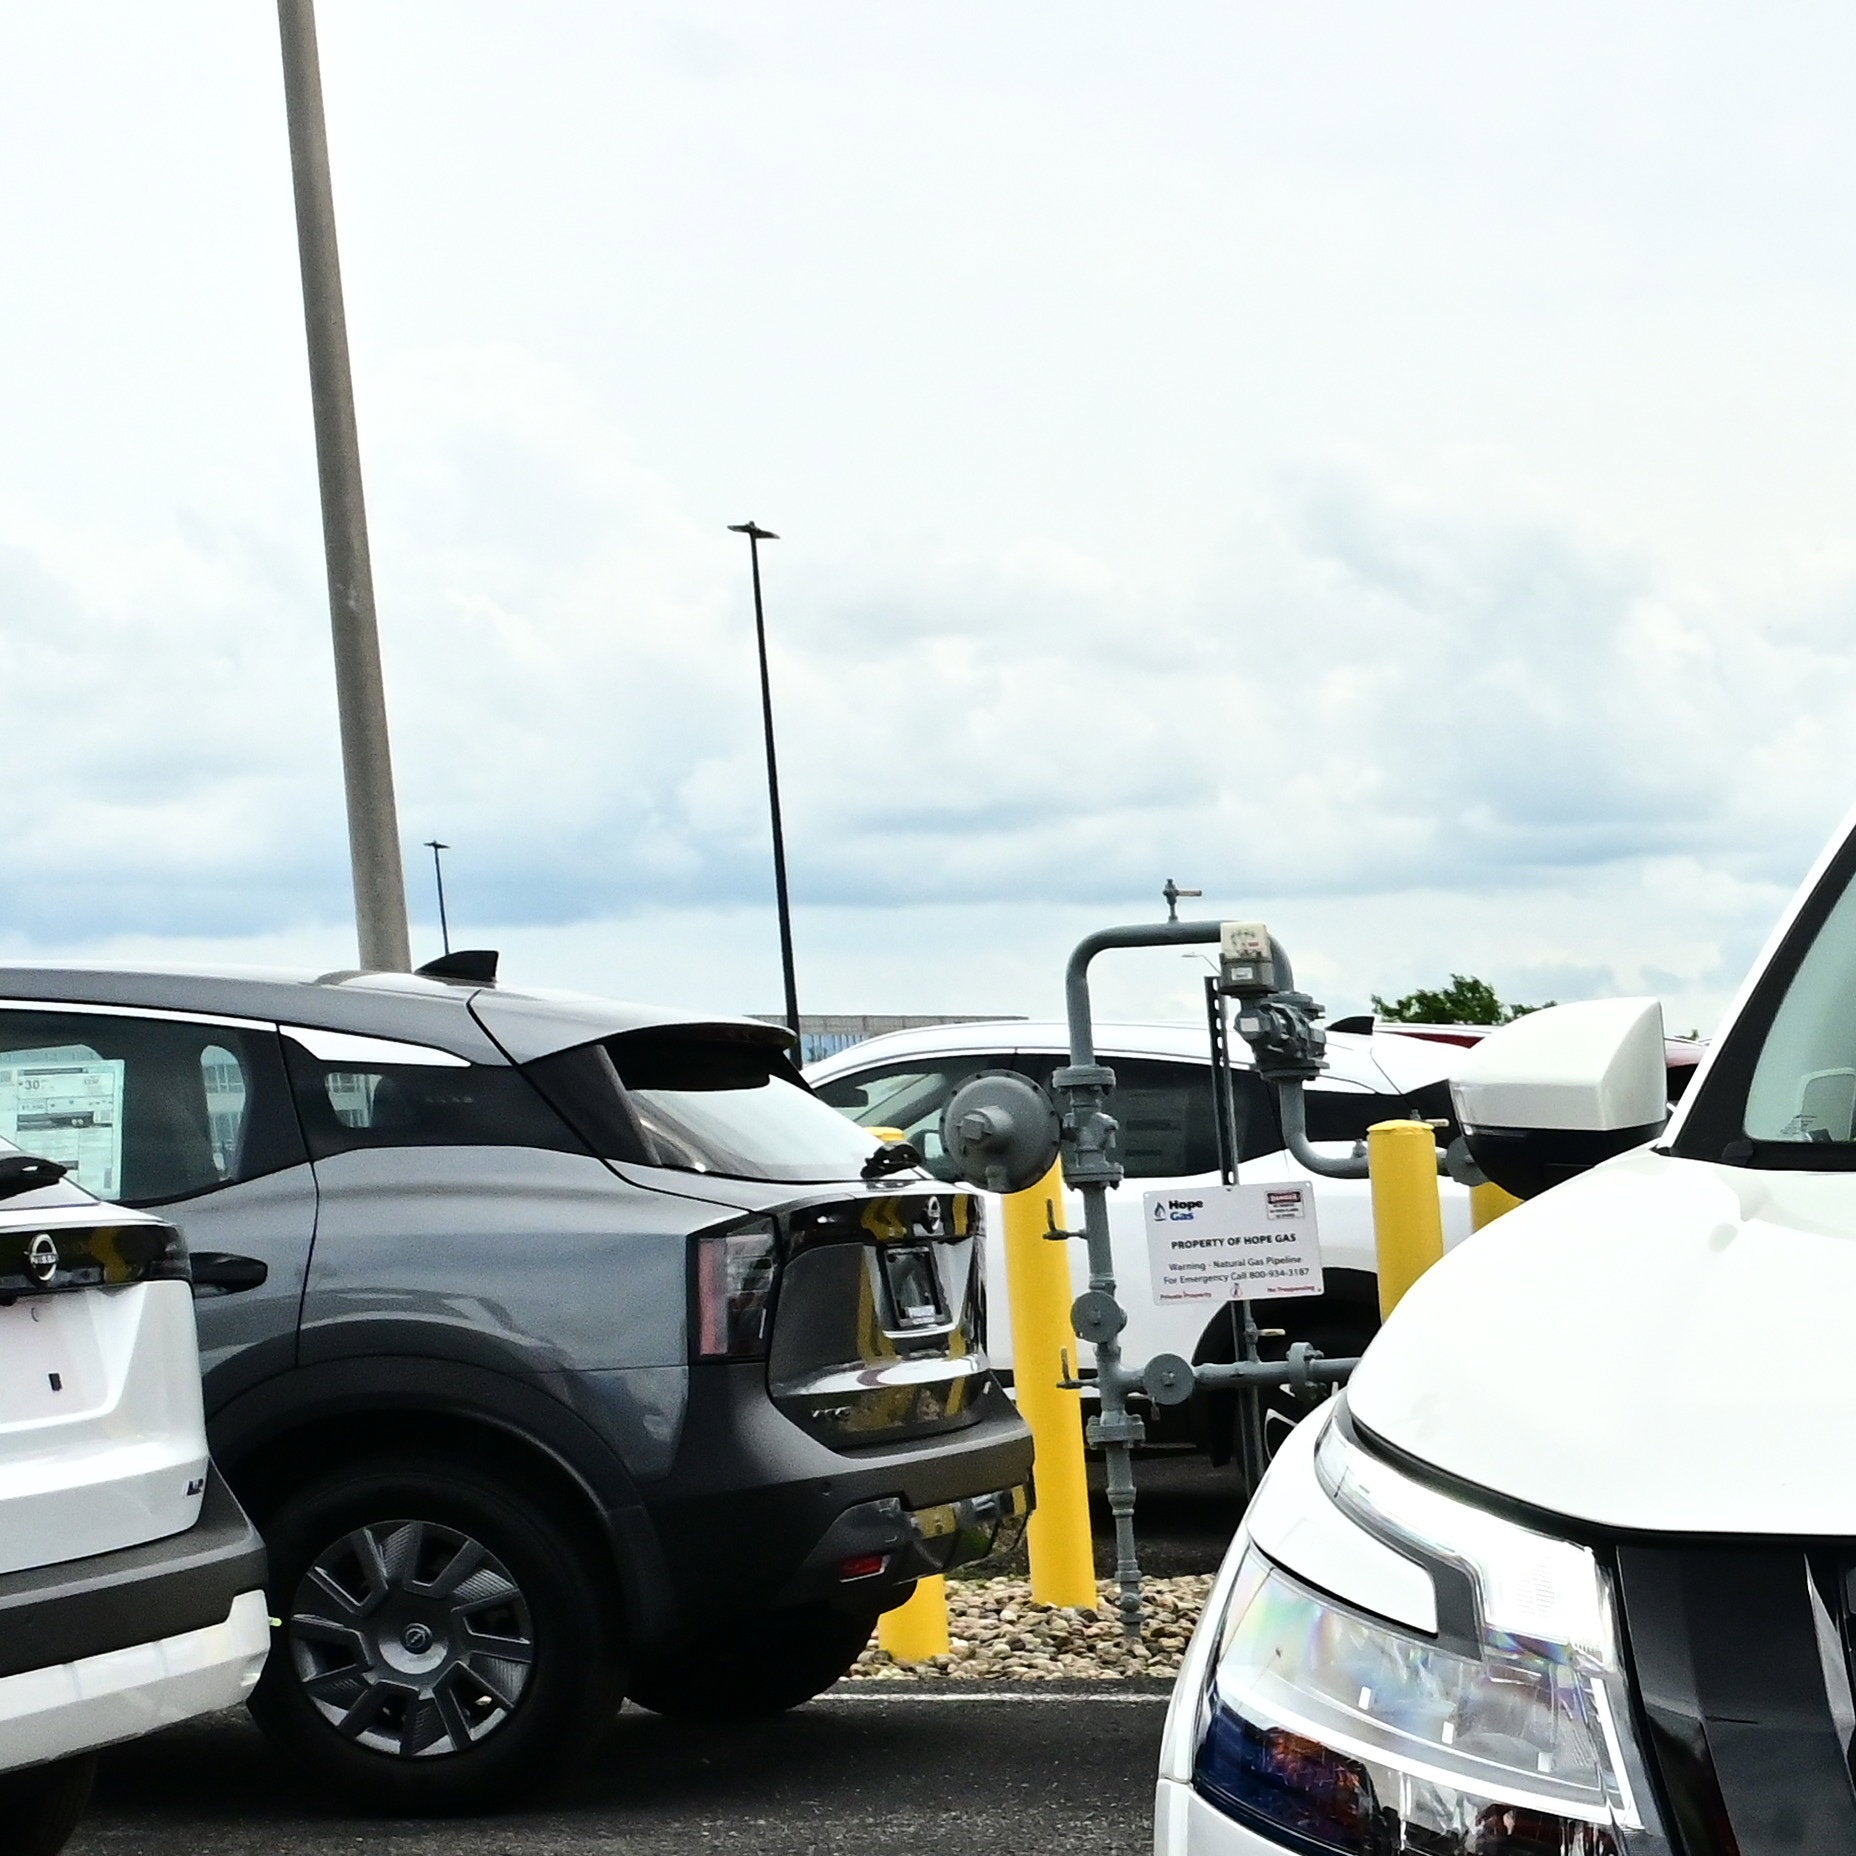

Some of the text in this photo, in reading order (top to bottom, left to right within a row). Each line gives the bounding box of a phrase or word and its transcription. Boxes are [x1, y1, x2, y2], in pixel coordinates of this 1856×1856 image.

[1168, 1200, 1203, 1211] Hope
[1170, 1211, 1194, 1221] Gas
[1171, 1233, 1296, 1250] PROPERTY OF HOPE GAS
[1168, 1262, 1206, 1272] Warning
[1213, 1260, 1246, 1269] Natural
[1248, 1259, 1264, 1267] Gas
[1266, 1256, 1301, 1267] Pipeline
[1163, 1276, 1177, 1285] For
[1180, 1274, 1228, 1285] Emergency
[1231, 1271, 1247, 1281] Call
